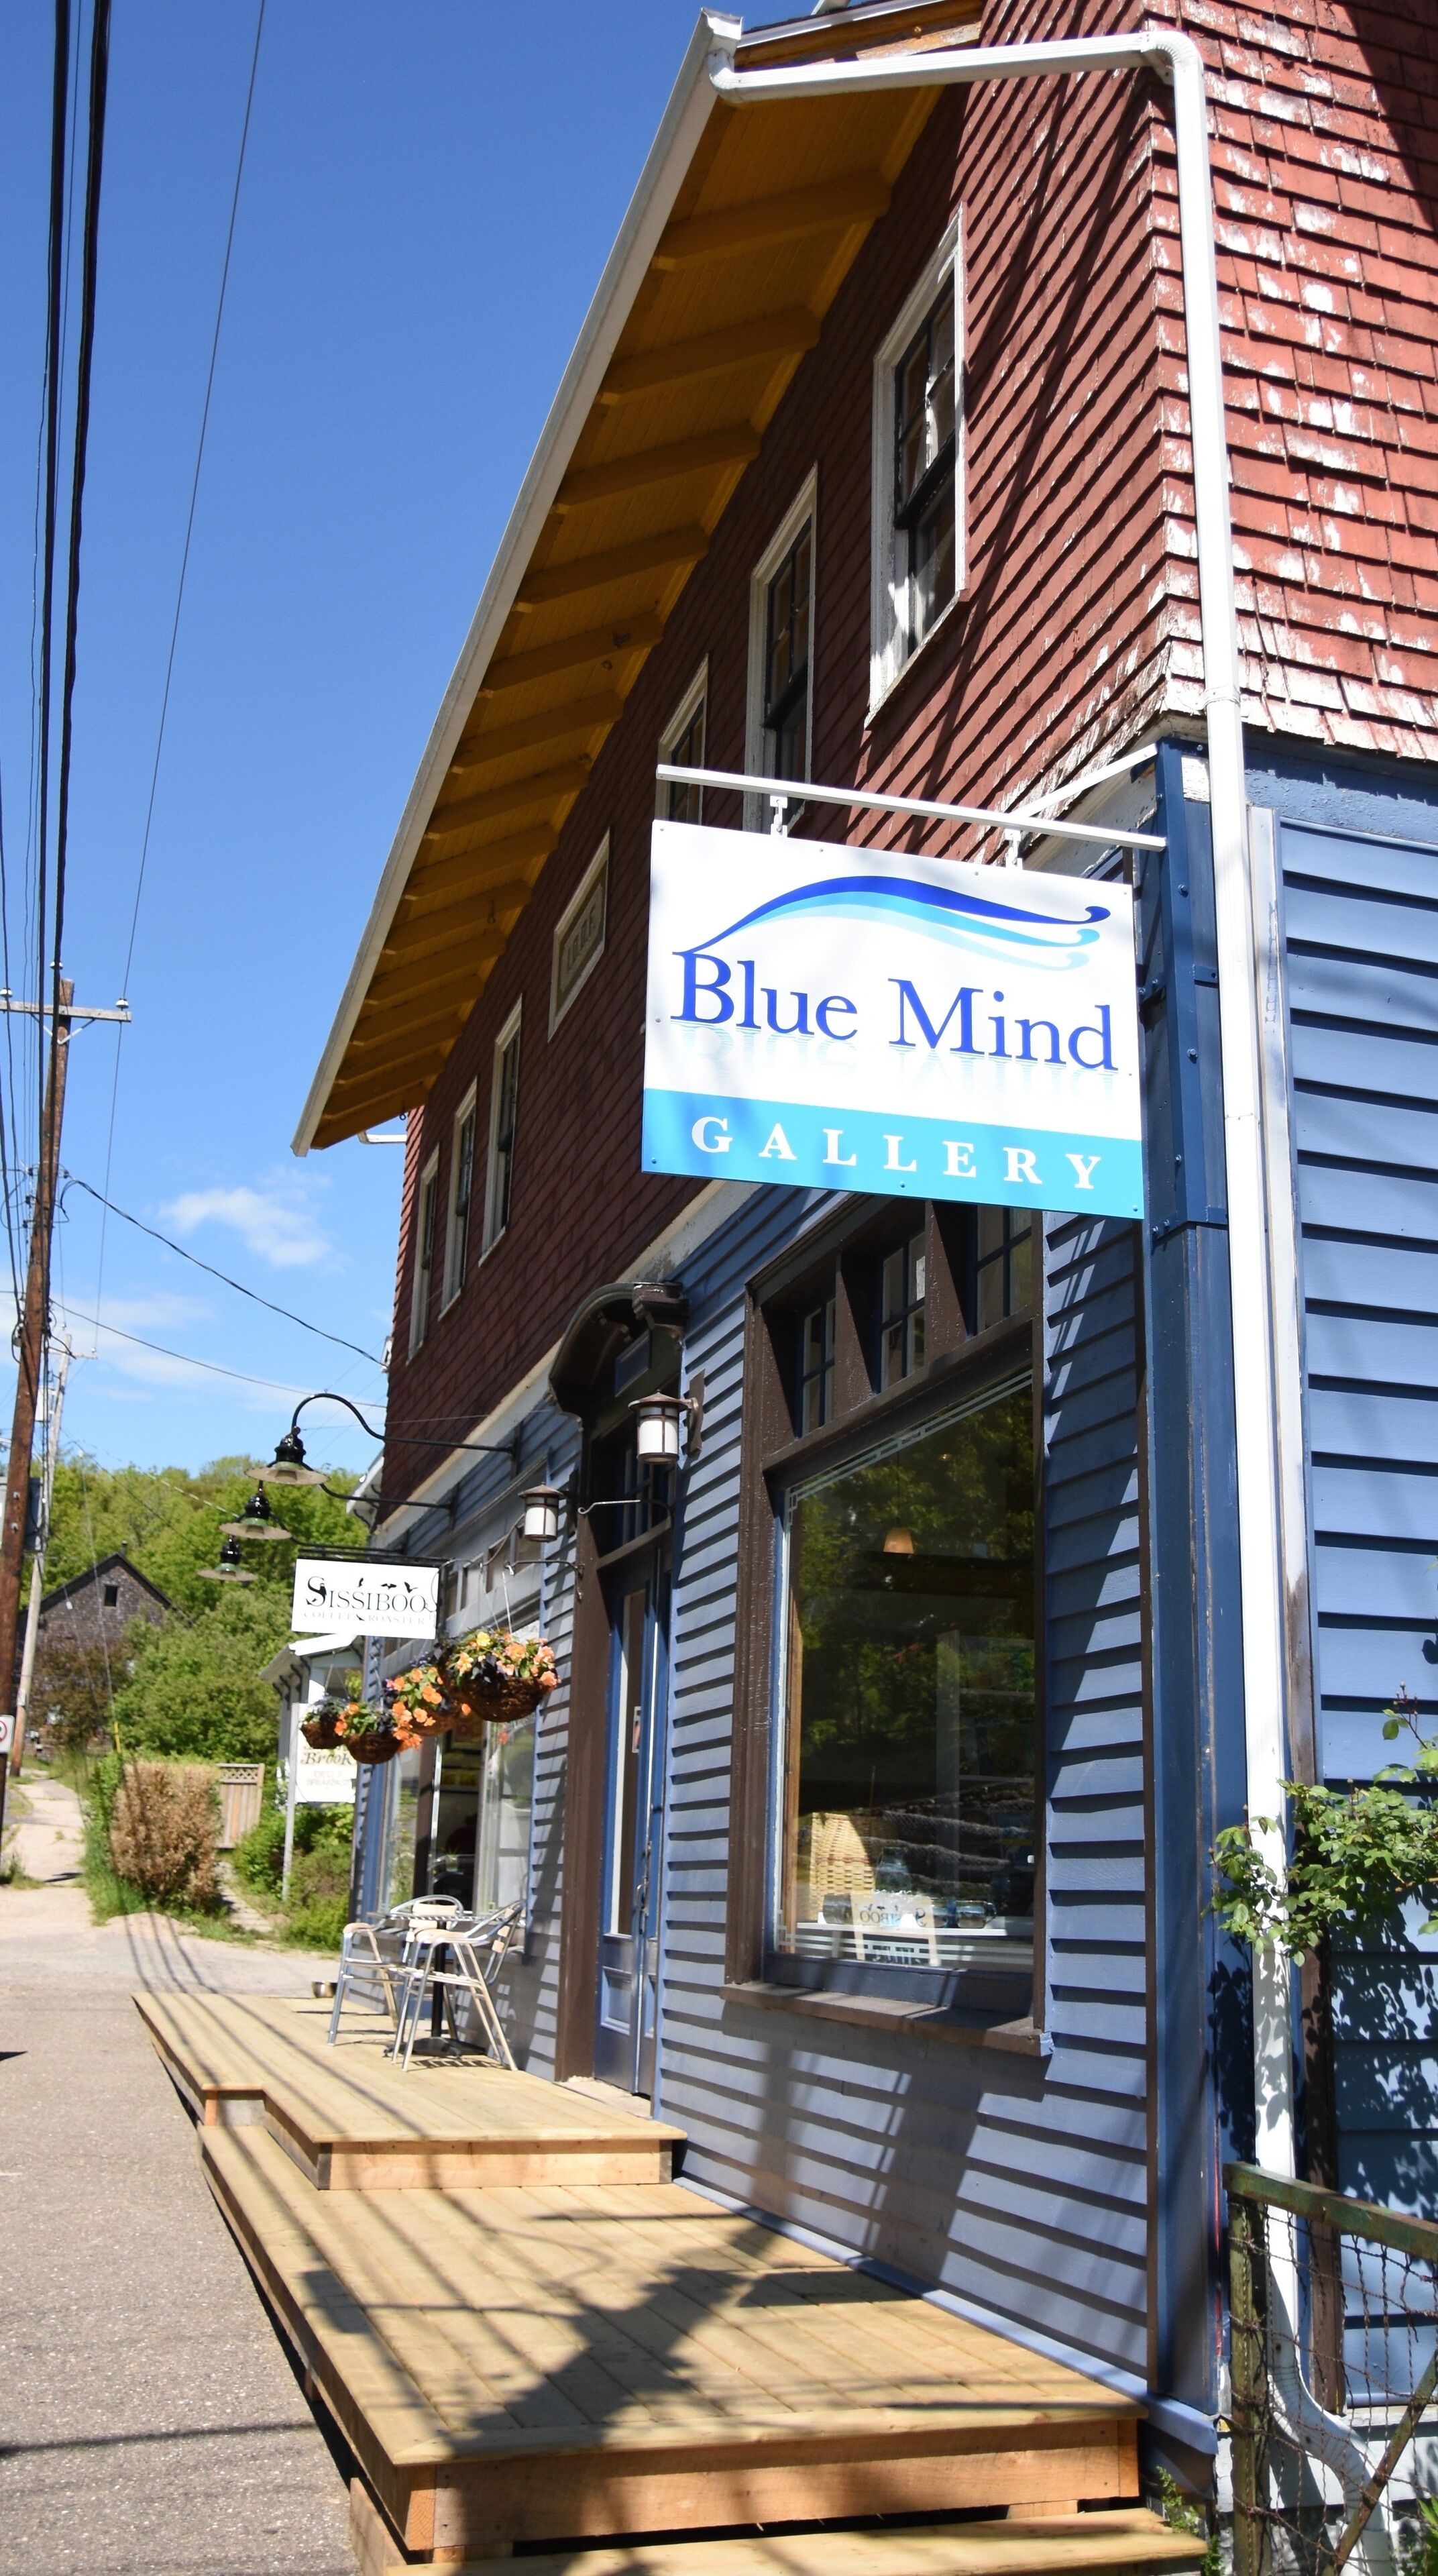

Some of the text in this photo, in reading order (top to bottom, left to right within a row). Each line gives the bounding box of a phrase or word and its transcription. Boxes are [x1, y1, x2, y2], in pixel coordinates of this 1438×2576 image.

[671, 951, 1119, 1071] Blue Mind
[691, 1116, 1102, 1190] GALLERY
[303, 1611, 351, 1620] COFFEE
[305, 1576, 427, 1613] SISSIBOO
